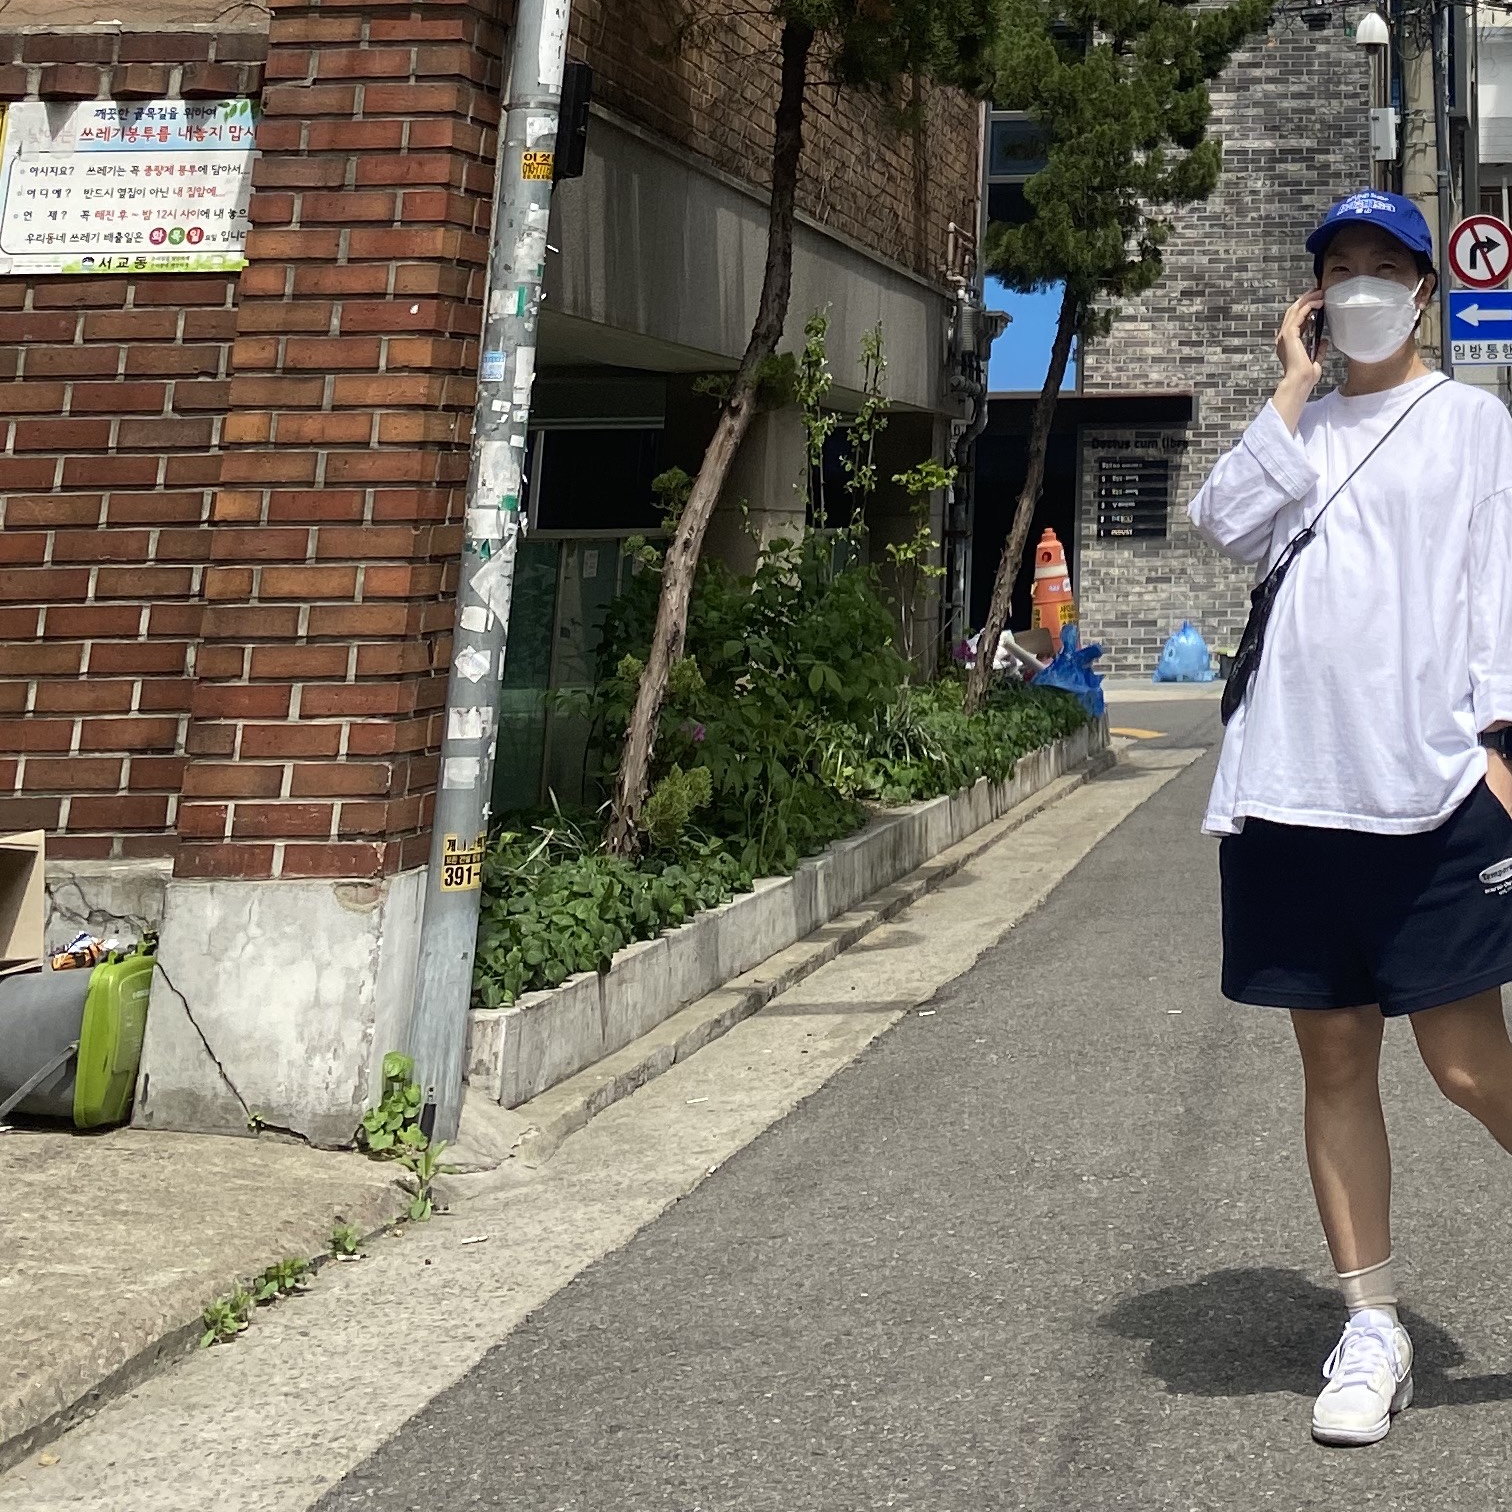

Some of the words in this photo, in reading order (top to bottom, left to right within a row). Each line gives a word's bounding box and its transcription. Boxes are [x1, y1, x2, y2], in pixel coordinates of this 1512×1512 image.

[134, 107, 178, 120] 골목길을
[184, 106, 217, 119] 위하여
[79, 125, 171, 143] 쓰레기봉투를
[178, 125, 222, 142] 내놓지
[86, 165, 126, 177] 쓰레기는
[84, 187, 114, 199] 반드시
[25, 232, 67, 244] 우리동네
[69, 232, 101, 244] 쓰레기
